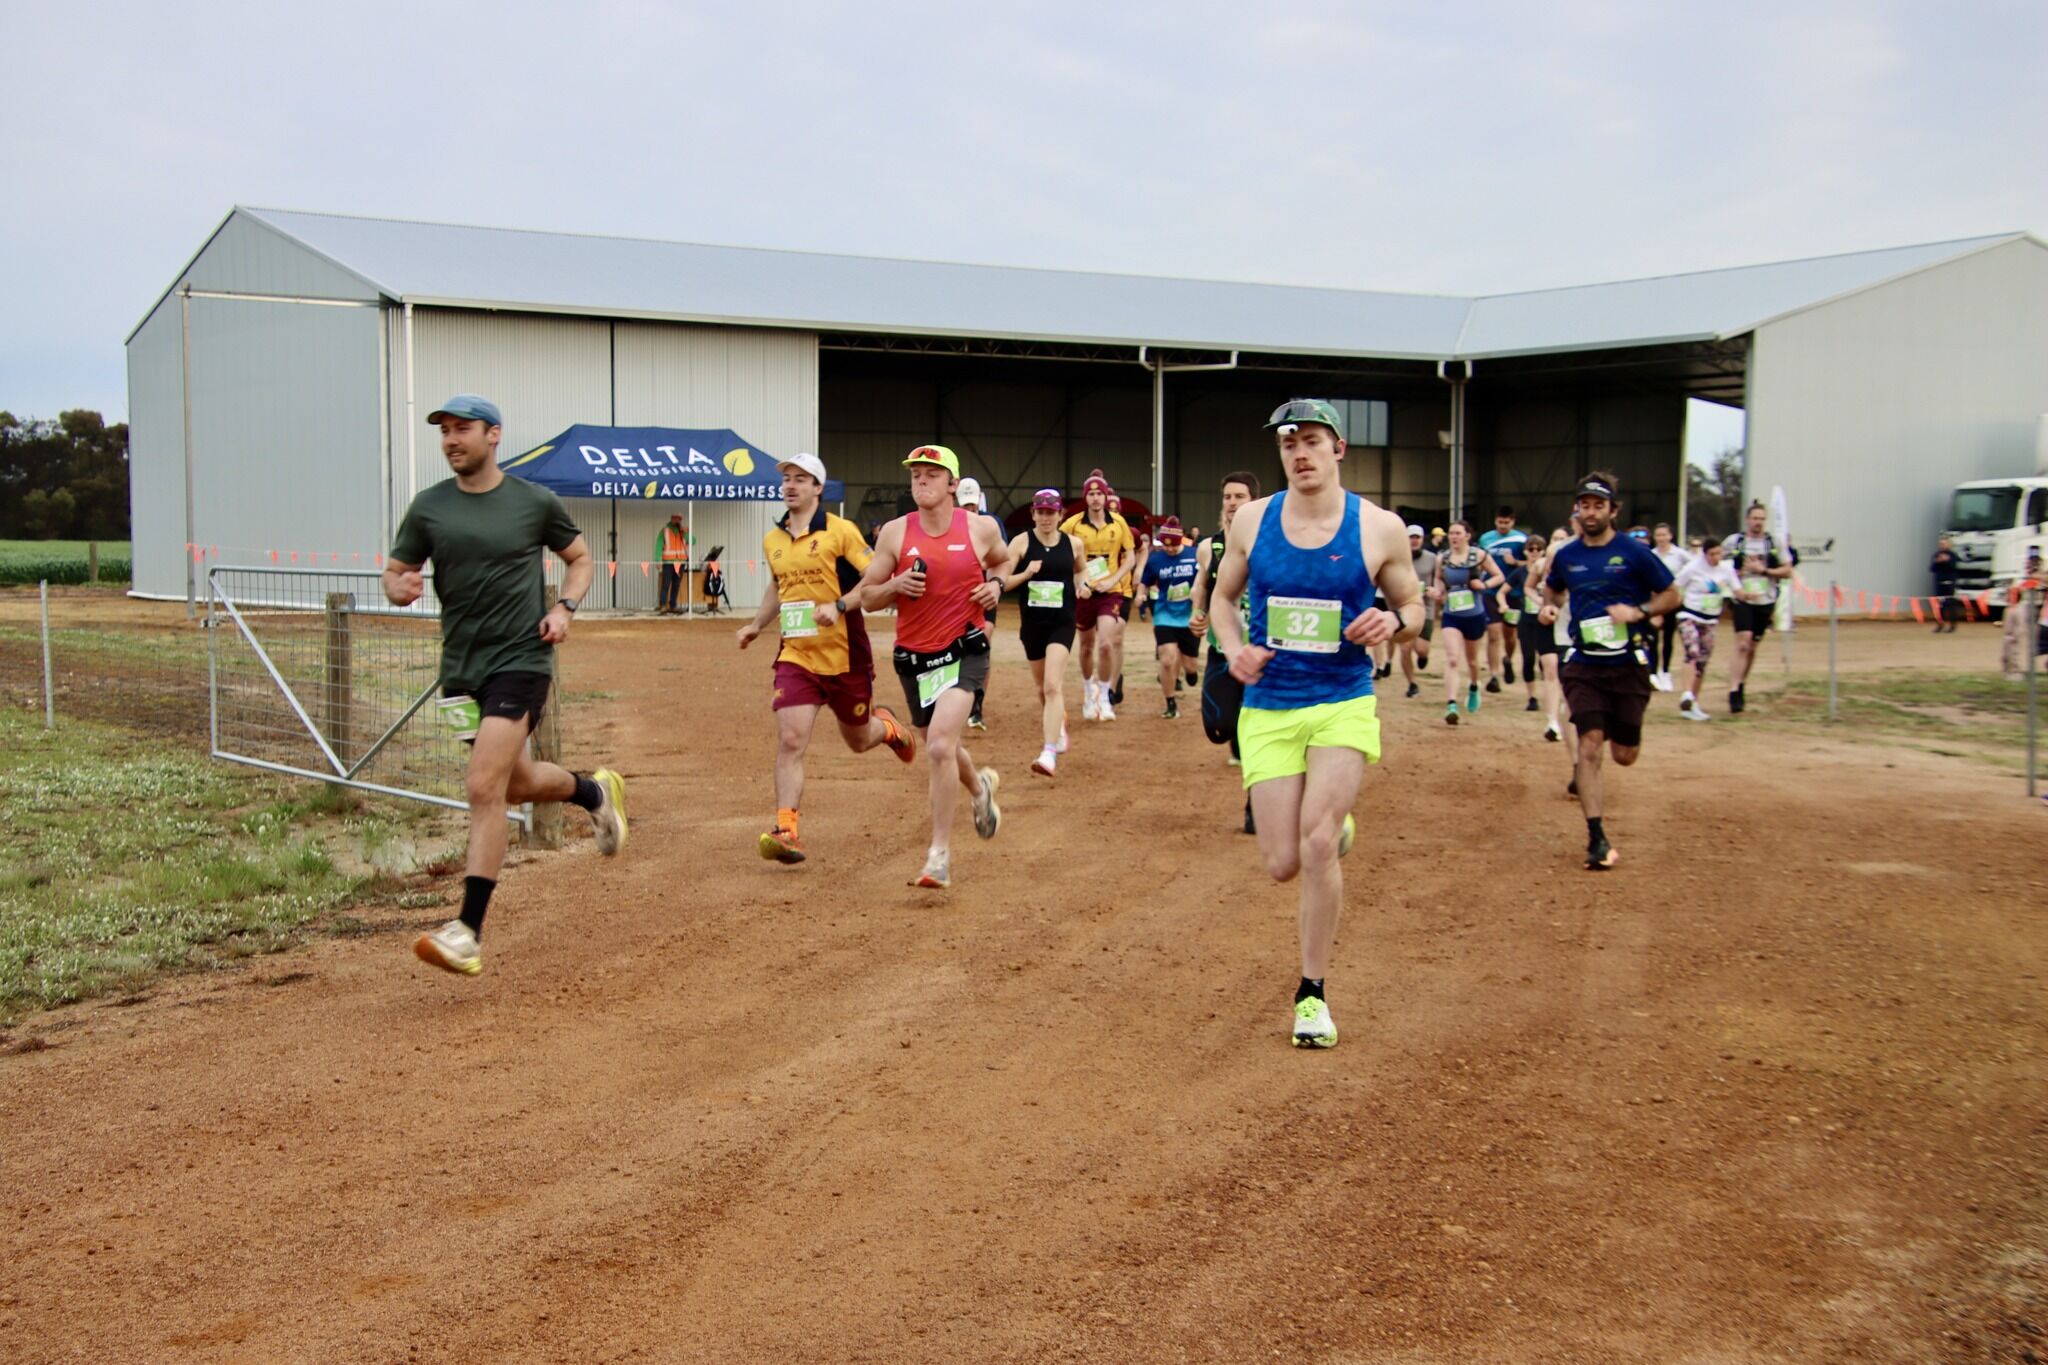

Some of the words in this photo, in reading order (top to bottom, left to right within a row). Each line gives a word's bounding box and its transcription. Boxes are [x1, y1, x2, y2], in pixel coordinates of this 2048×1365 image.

[579, 445, 715, 467] DELTA
[594, 466, 722, 476] AGRIBUSINESS
[592, 481, 640, 496] DELTA
[661, 485, 784, 498] AGRIBUSINESS
[786, 610, 804, 627] 37
[1286, 611, 1319, 636] 32
[926, 652, 953, 668] nerd
[930, 670, 946, 692] 21
